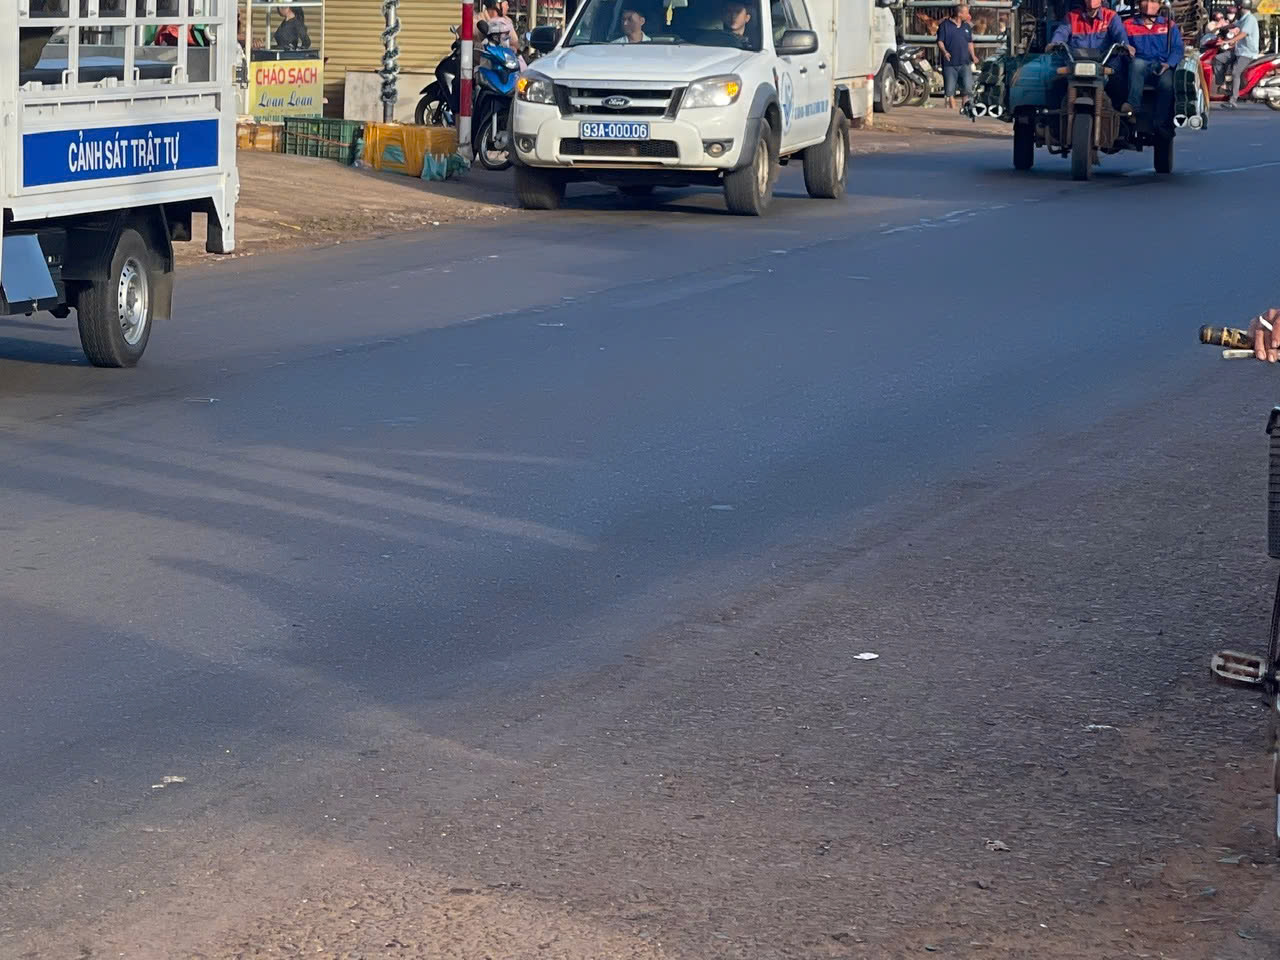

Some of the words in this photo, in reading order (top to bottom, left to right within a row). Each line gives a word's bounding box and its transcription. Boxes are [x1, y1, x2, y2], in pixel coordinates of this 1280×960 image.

[256, 63, 286, 85] CHÁO
[288, 66, 317, 88] SẠCH
[259, 93, 284, 107] Loan
[288, 91, 312, 106] Loan
[608, 97, 625, 106] Ford
[583, 123, 648, 138] 93A-000.06
[68, 130, 103, 173] CẢNH
[105, 131, 128, 170] SÁT
[130, 130, 161, 172] TRẬT
[163, 131, 180, 170] TỰ
